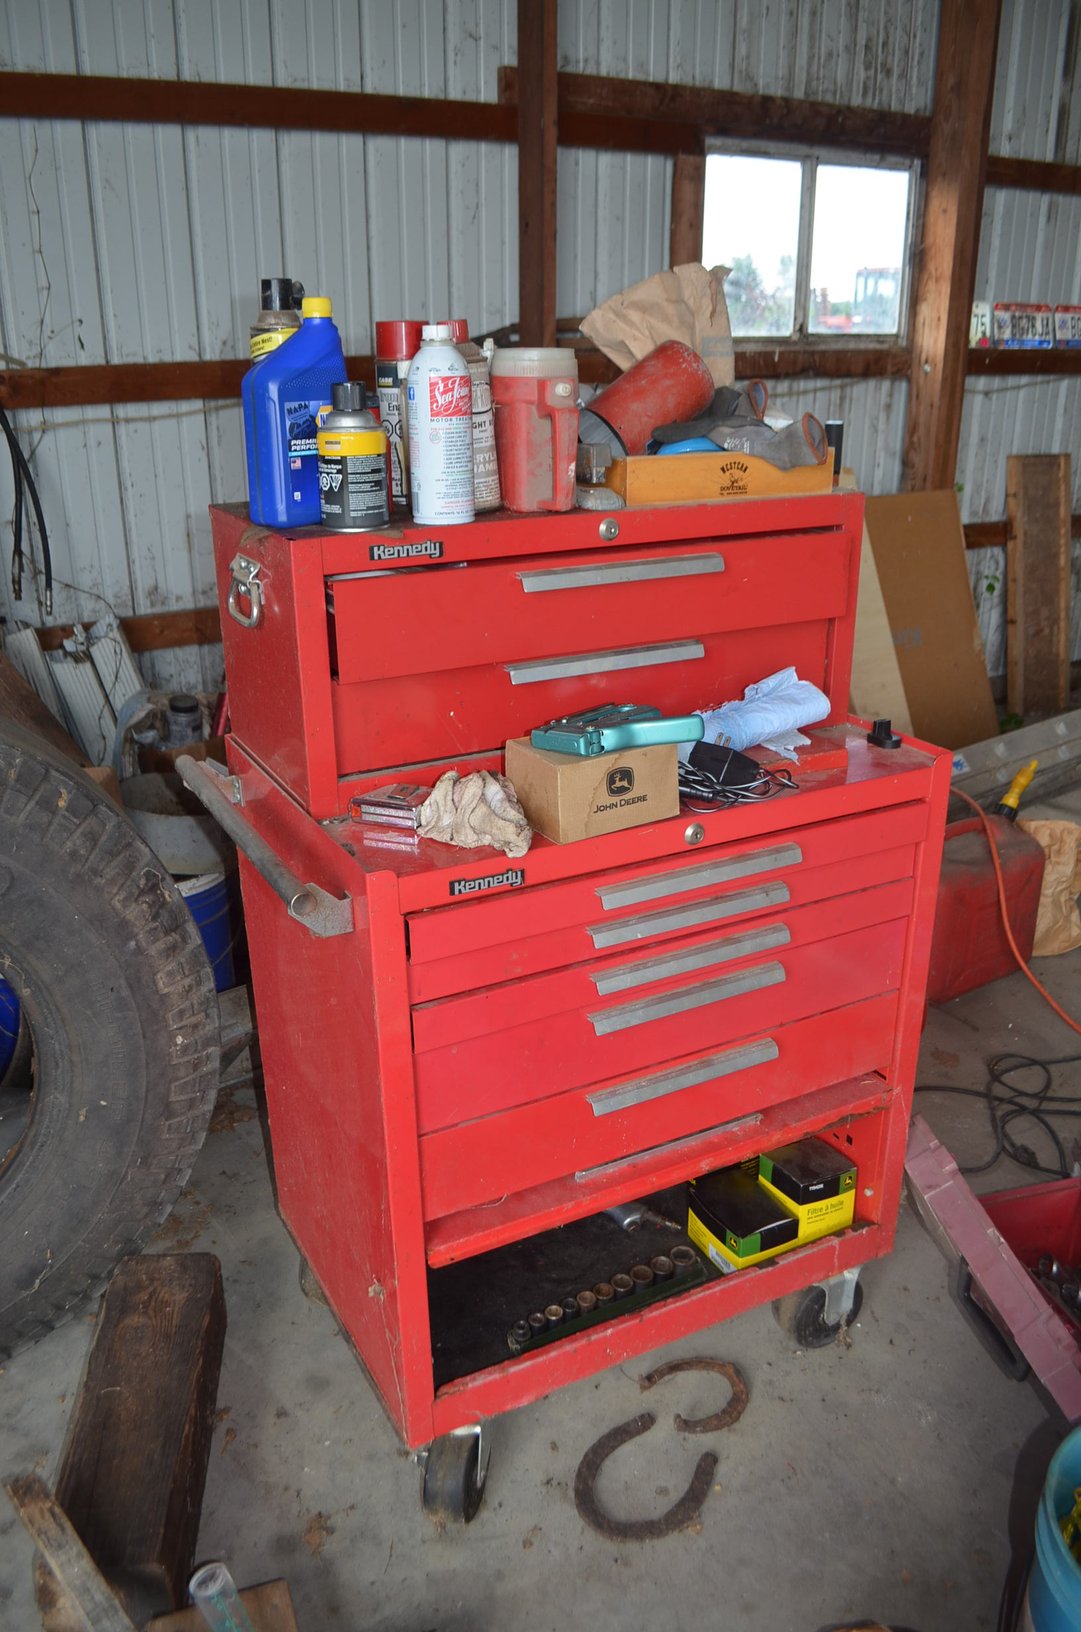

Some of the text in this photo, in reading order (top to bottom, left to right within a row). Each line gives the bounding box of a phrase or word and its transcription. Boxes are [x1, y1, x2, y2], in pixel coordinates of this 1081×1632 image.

[720, 461, 749, 474] WESTERN
[373, 540, 440, 560] Kennedy
[593, 794, 648, 814] JOHN DEERE
[454, 870, 521, 895] Kennedy
